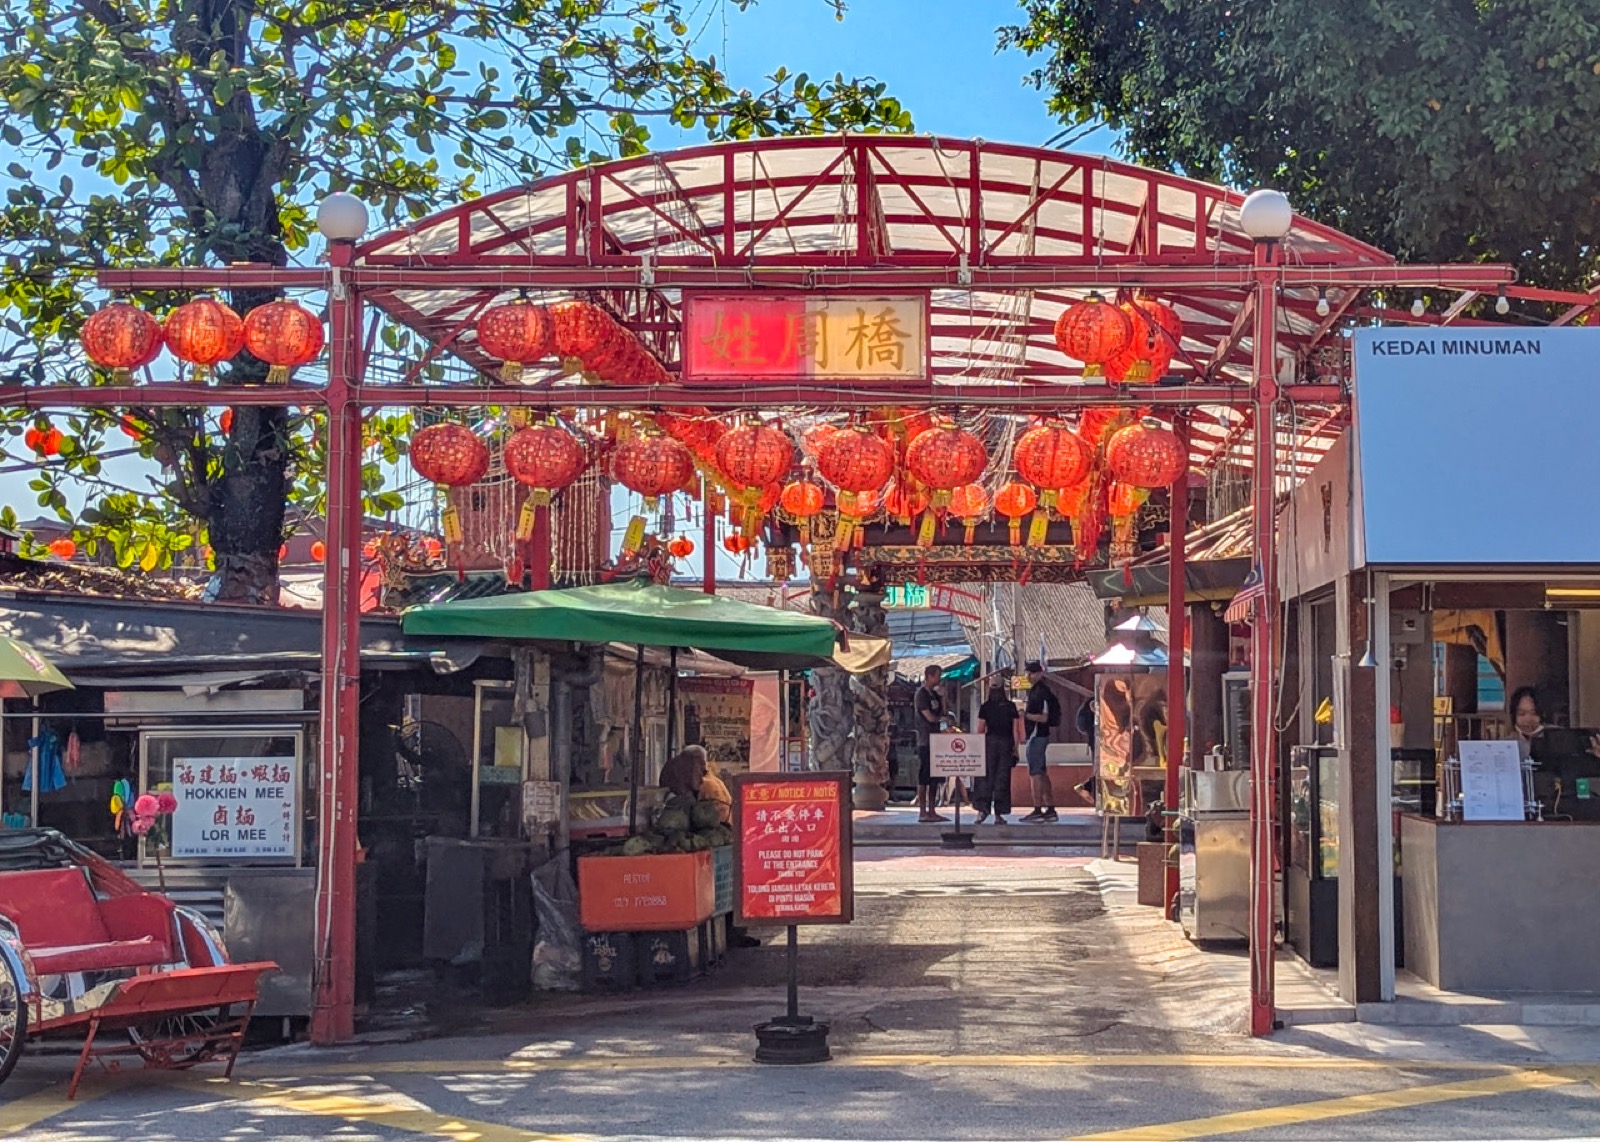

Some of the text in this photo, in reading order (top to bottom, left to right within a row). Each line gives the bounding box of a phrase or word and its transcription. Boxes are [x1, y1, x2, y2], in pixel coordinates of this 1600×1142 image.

[702, 304, 911, 370] 姓周橋
[1372, 339, 1541, 356] KEDAI MINUMAN
[185, 787, 285, 800] HOKKIEN MEE
[778, 787, 805, 798] NOTICE
[813, 786, 836, 798] NOTIS
[764, 822, 817, 835] 在出入口
[201, 829, 267, 841] LOR MEE
[758, 849, 824, 859] PLEASE DO NOT PARK
[763, 860, 819, 869] AT THE ENTRANCE
[747, 882, 836, 894] TOLONG JANGAN LETAK KERETA
[768, 893, 816, 903] DI PINTU MASUK
